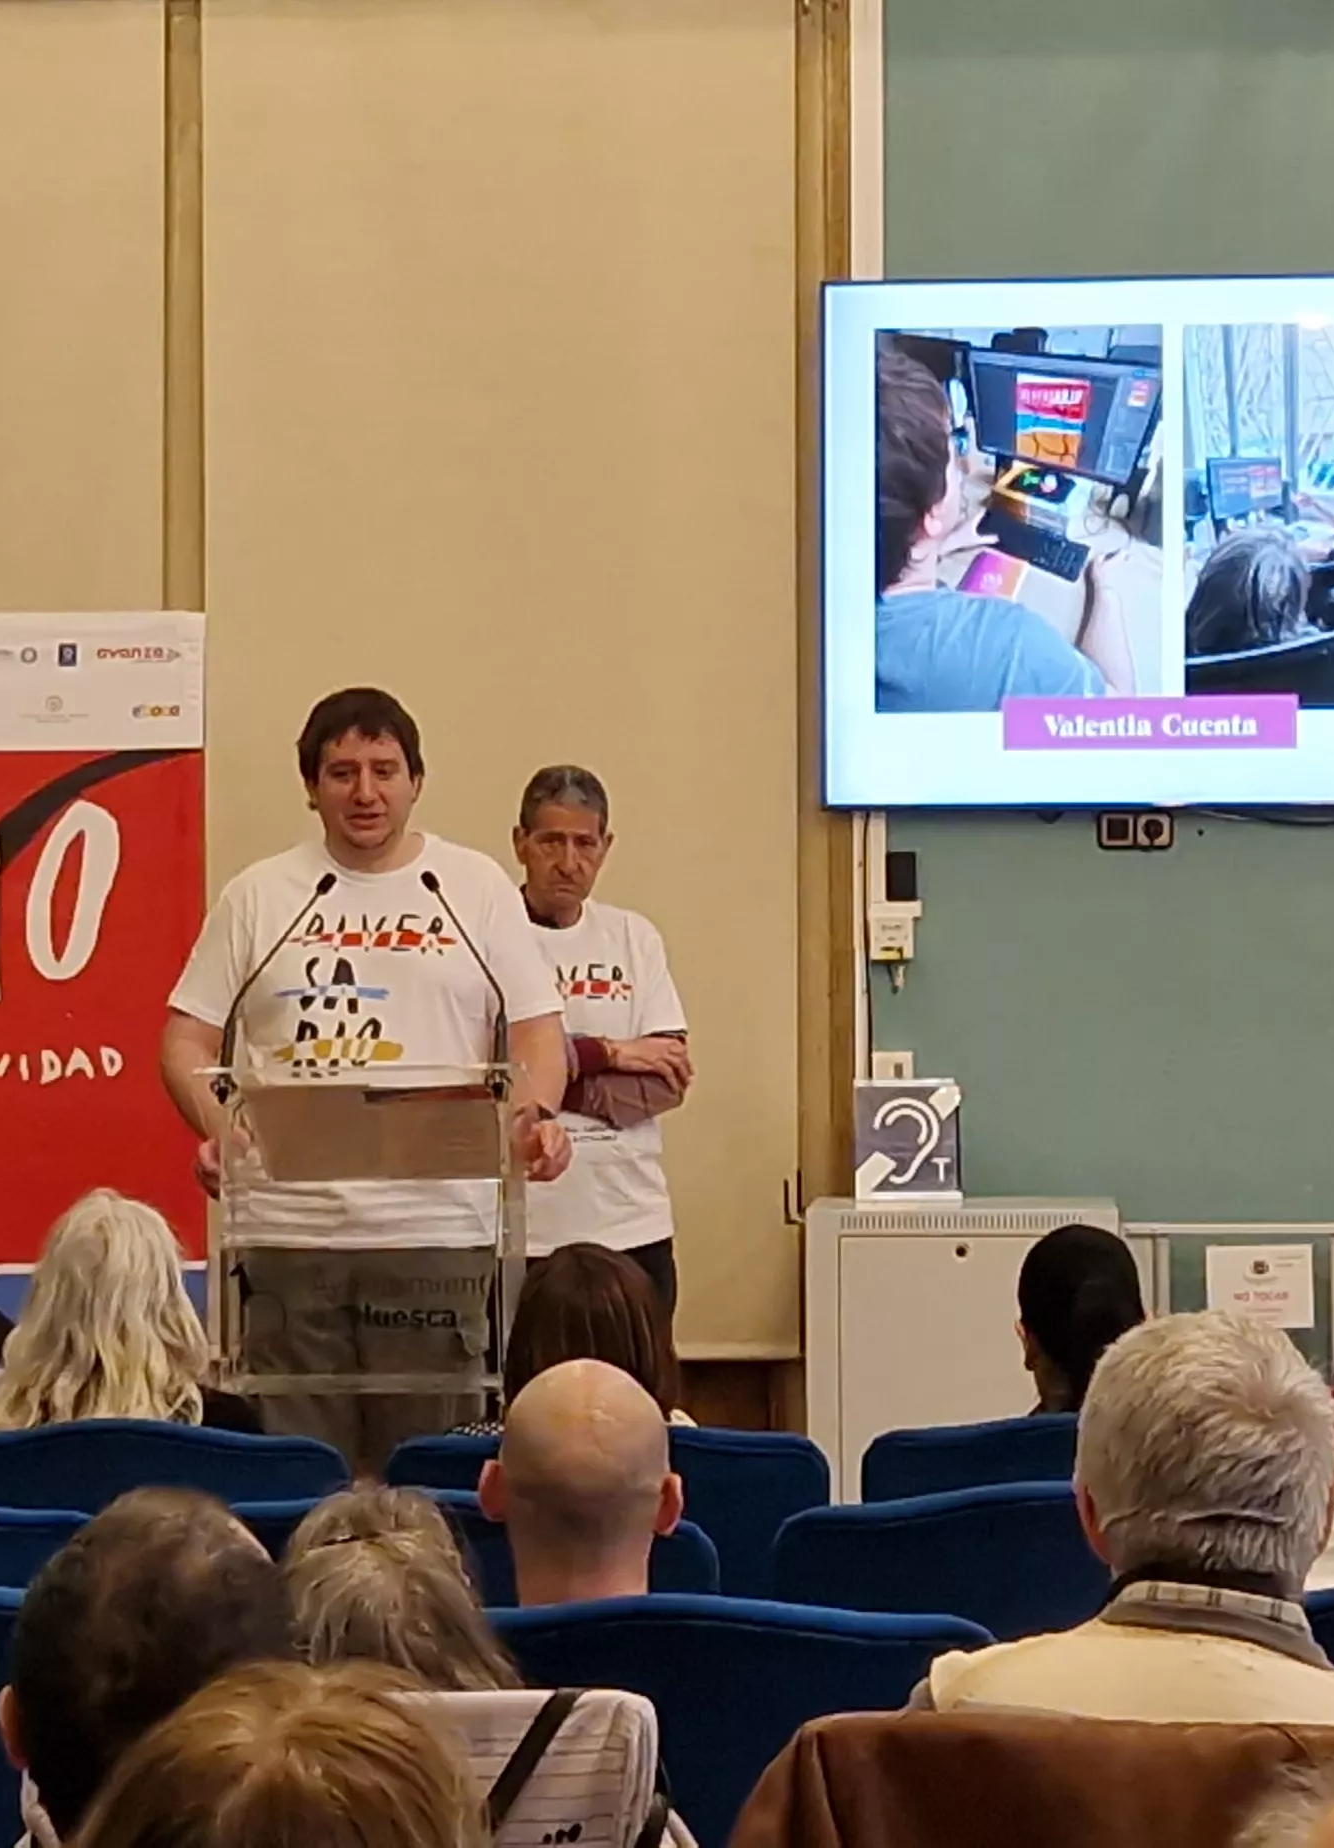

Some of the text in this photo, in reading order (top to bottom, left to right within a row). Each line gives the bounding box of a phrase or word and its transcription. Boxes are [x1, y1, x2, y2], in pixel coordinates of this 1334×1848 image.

[1162, 713, 1258, 737] Cuenta
[301, 912, 445, 956] DIVER
[299, 957, 359, 1014] SA
[291, 1017, 383, 1068] RIO
[930, 1156, 952, 1183] T
